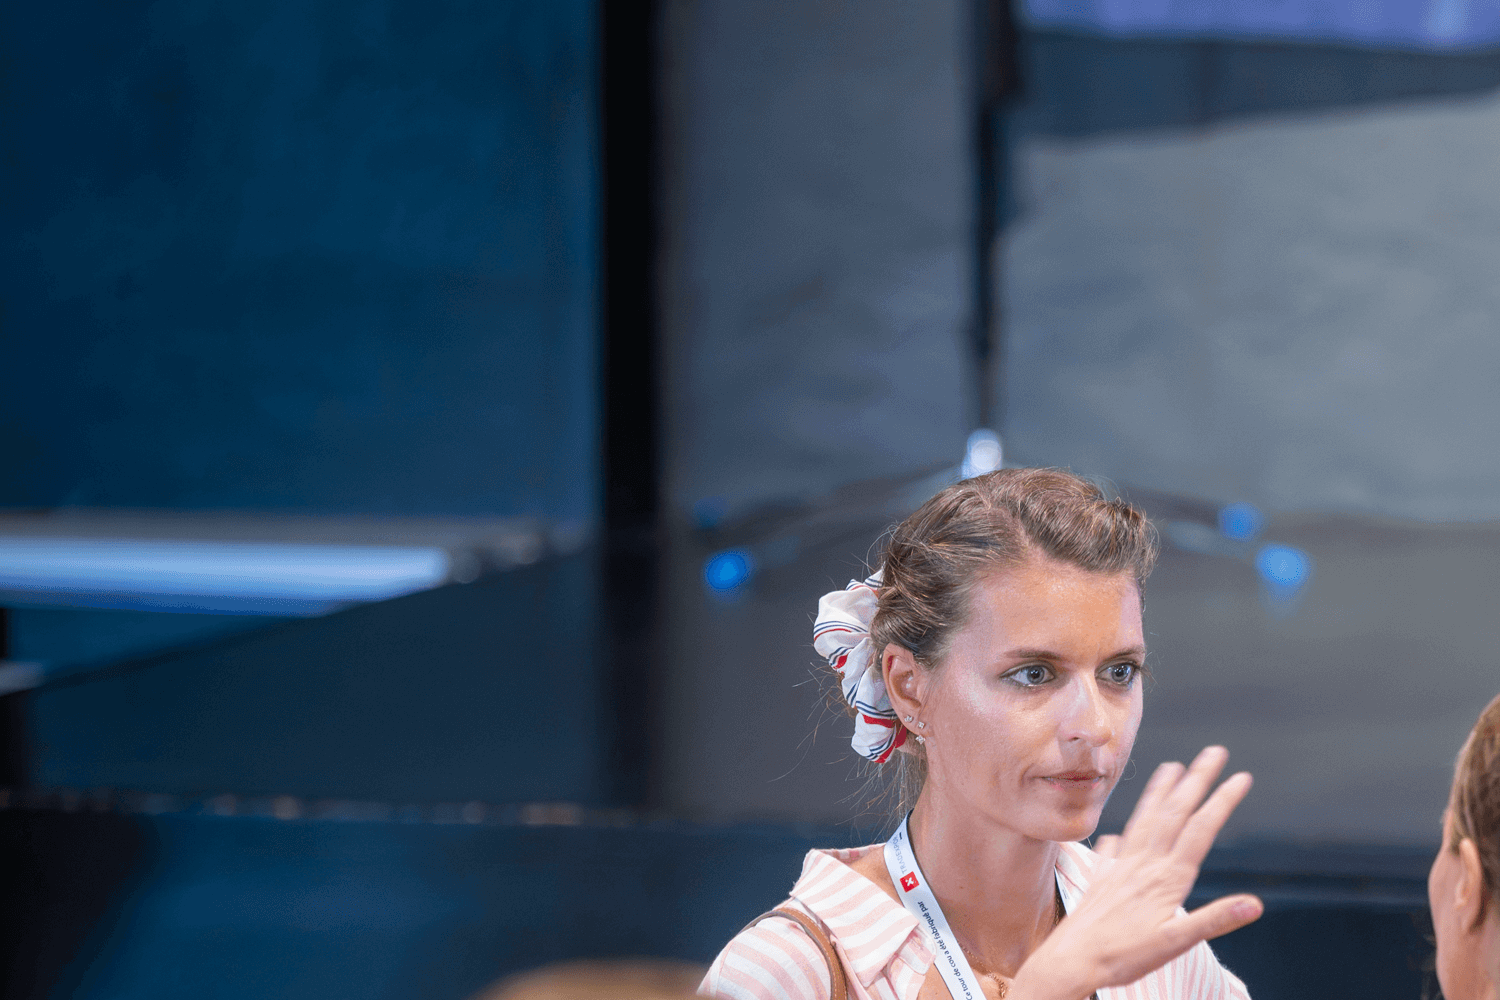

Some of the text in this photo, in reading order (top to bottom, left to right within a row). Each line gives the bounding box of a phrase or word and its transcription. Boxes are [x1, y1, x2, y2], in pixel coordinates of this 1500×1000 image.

[917, 901, 928, 912] par
[922, 911, 940, 940] fabriqué
[938, 937, 947, 950] été
[947, 955, 958, 968] cou
[953, 966, 963, 977] de
[958, 977, 969, 991] tour
[966, 990, 973, 1000] Ce
